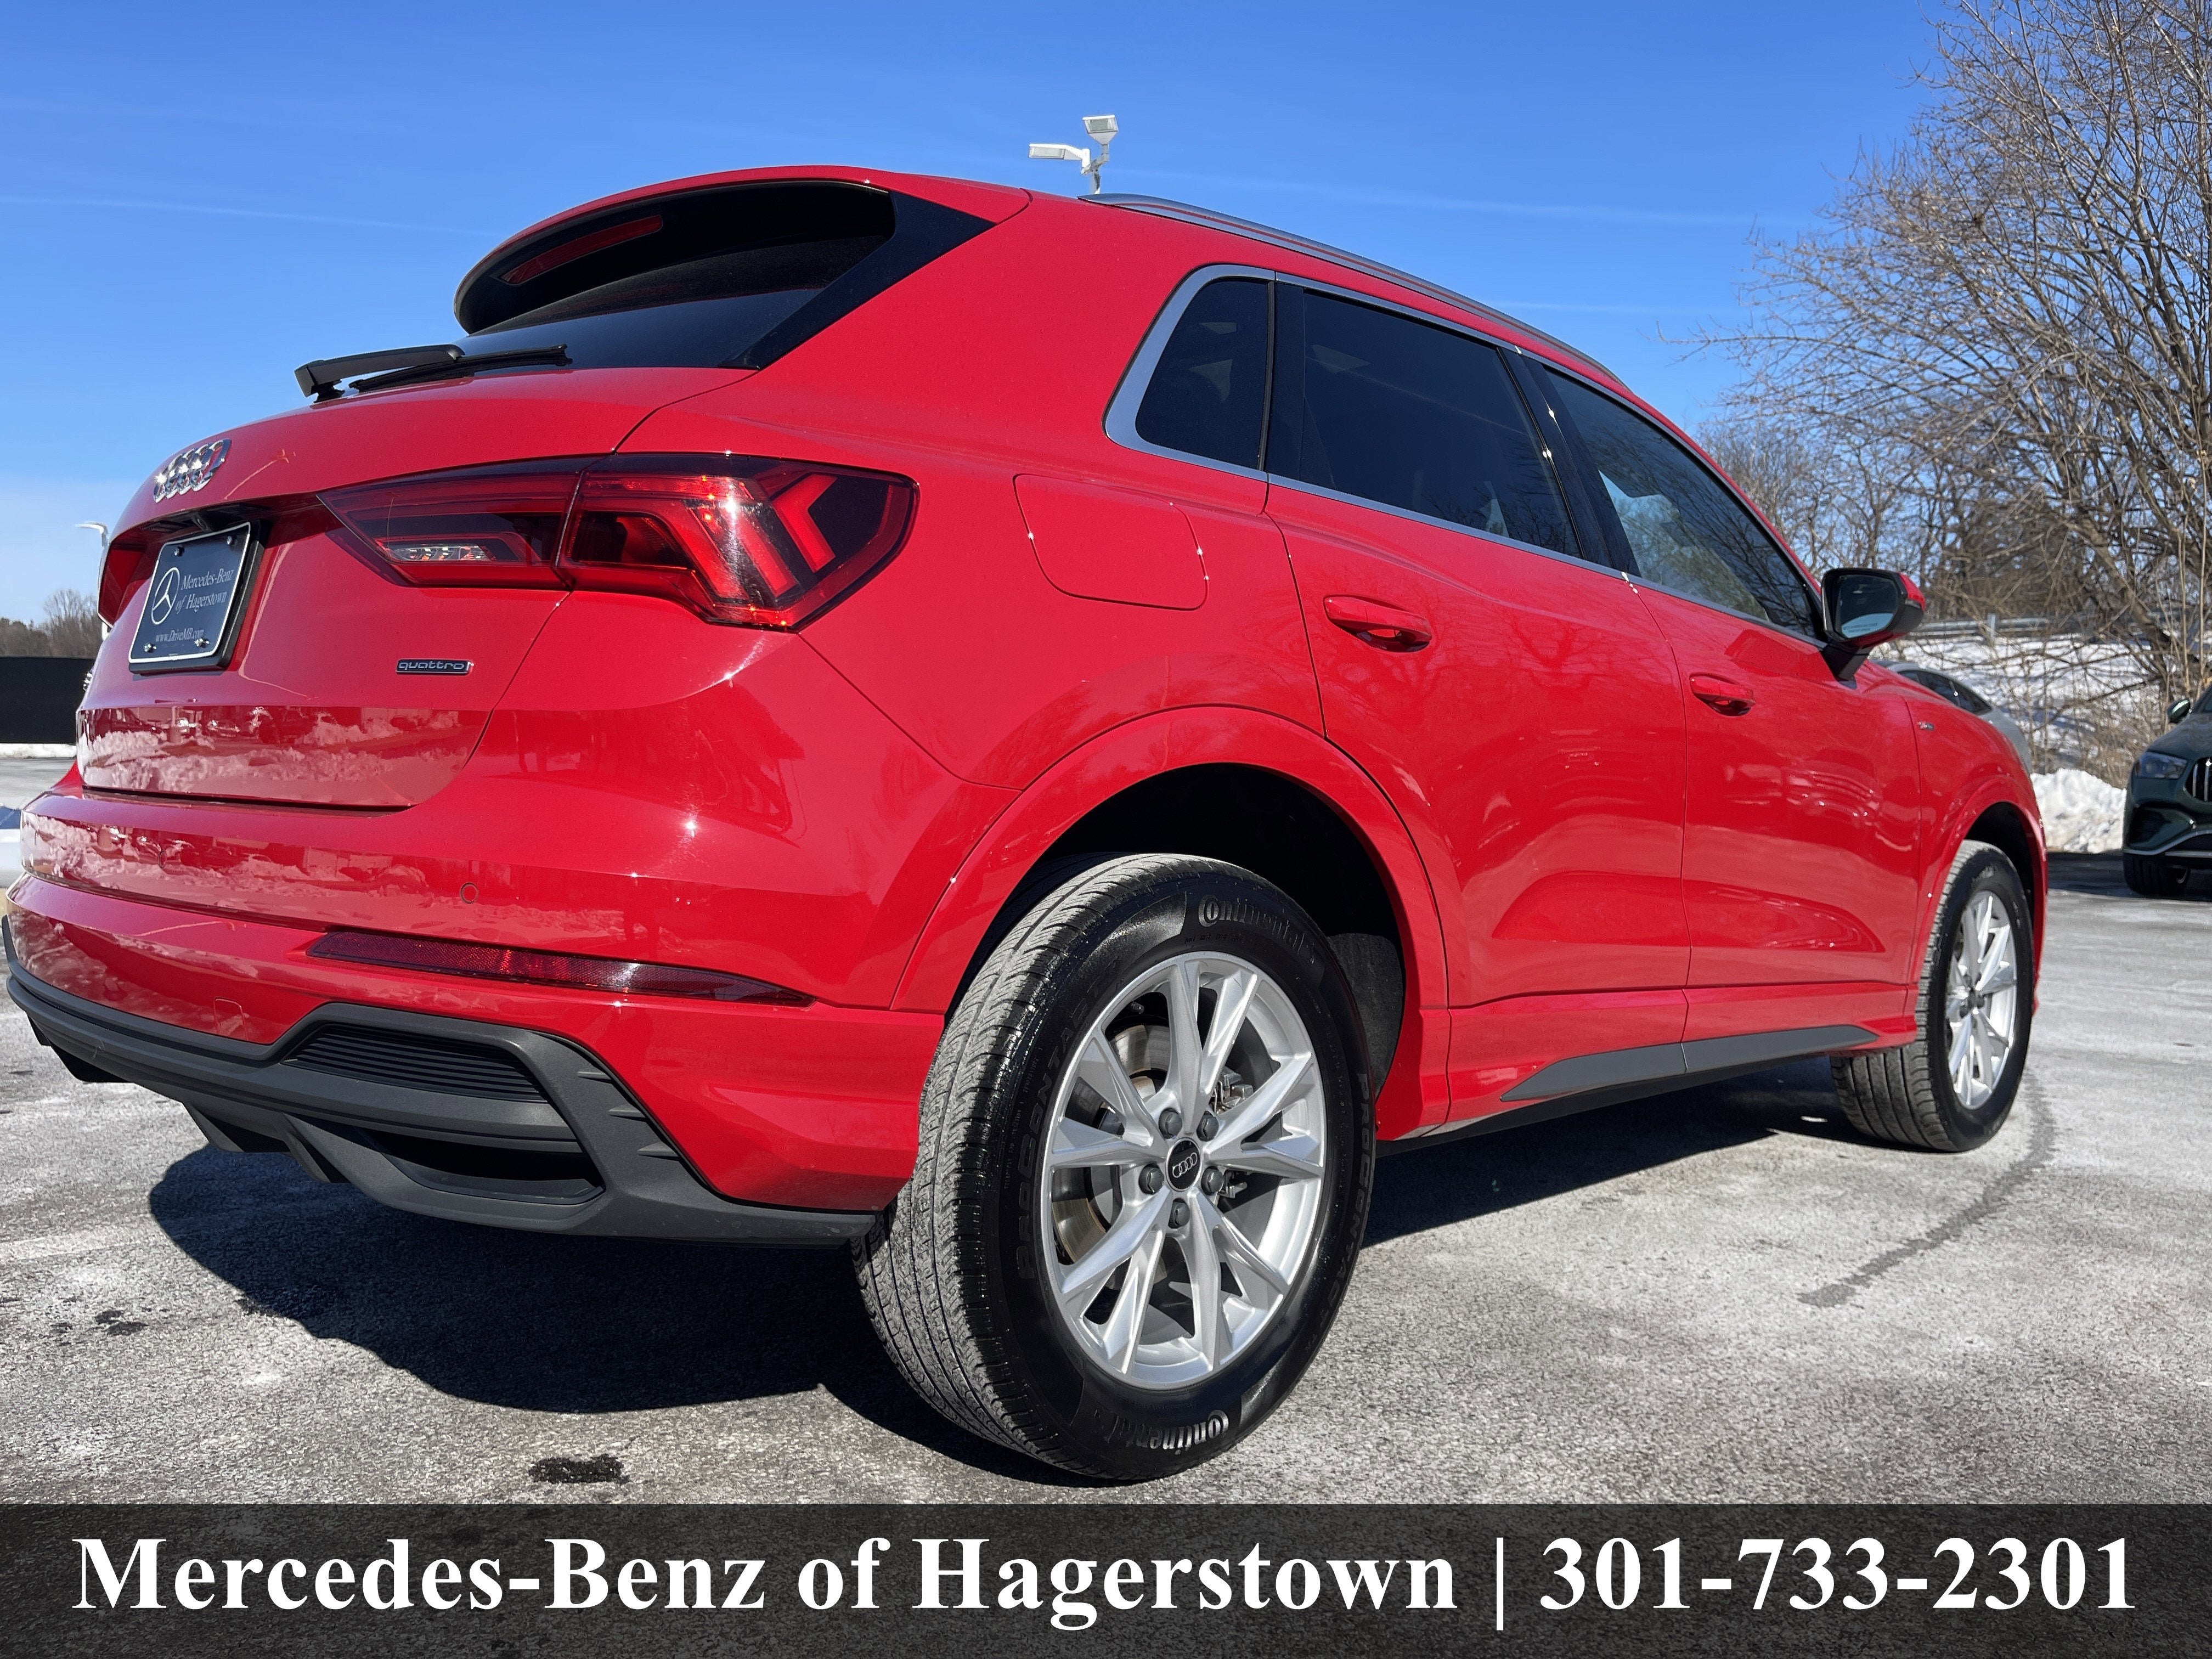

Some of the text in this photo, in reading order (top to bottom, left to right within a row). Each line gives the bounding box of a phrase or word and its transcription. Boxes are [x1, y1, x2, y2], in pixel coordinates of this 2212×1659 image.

[180, 568, 234, 590] Mercedes-Benz
[176, 591, 227, 614] of Hagerstown
[399, 661, 465, 670] quattro
